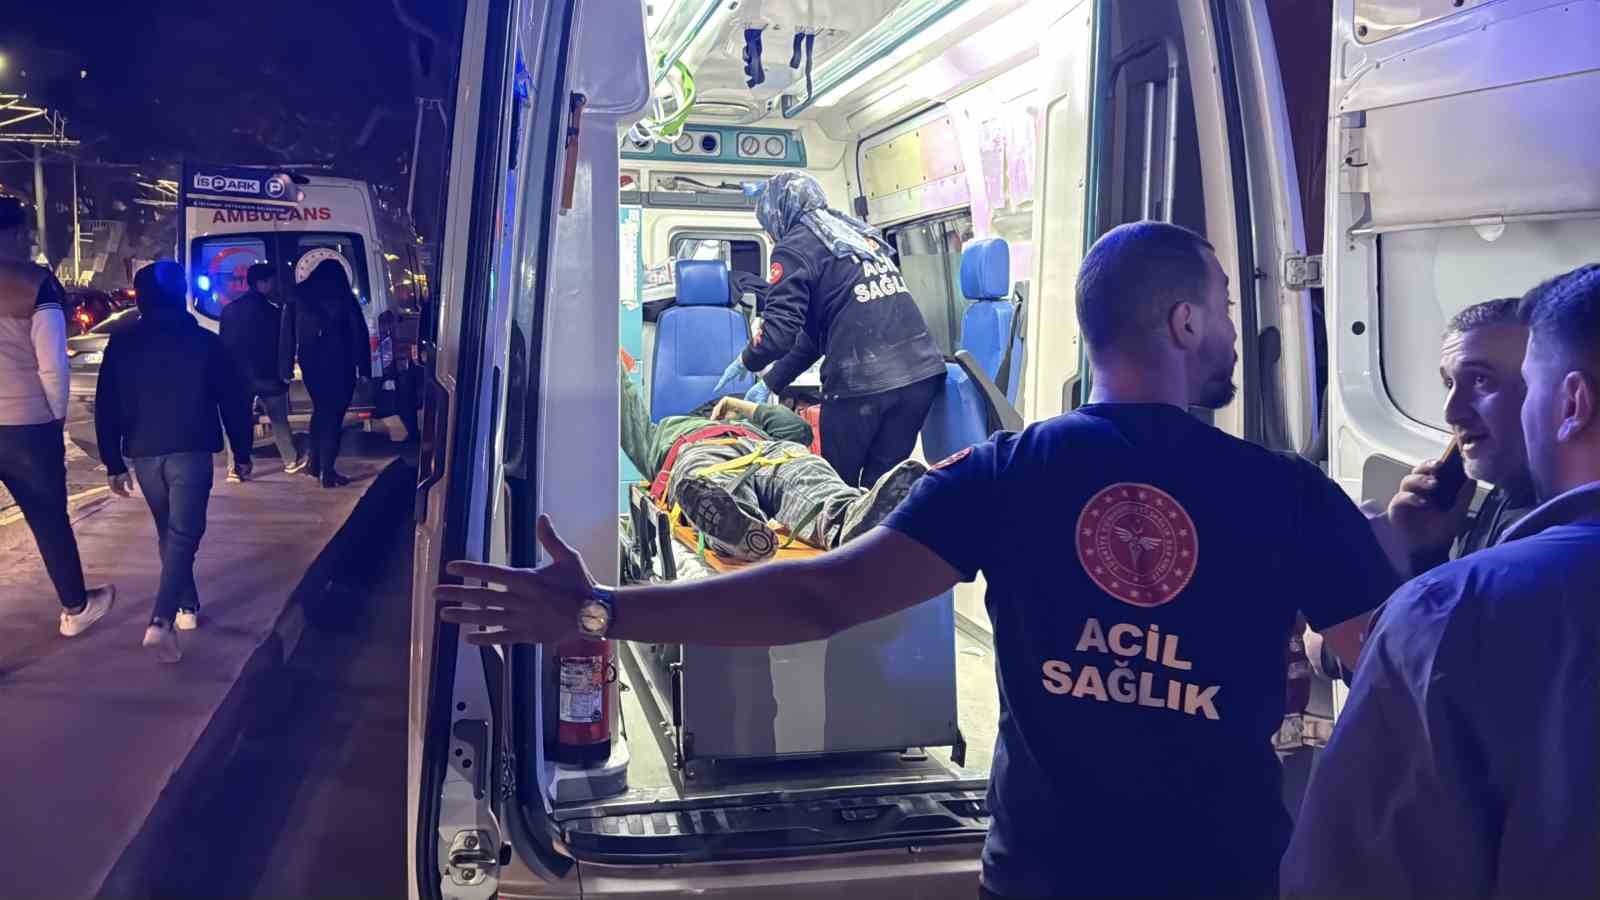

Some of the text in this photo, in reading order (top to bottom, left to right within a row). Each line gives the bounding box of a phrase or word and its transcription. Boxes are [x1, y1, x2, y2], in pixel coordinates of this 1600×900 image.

[212, 207, 332, 224] AMBULANS
[1075, 617, 1193, 671] ACİL
[1041, 659, 1221, 721] SAĞLIK
